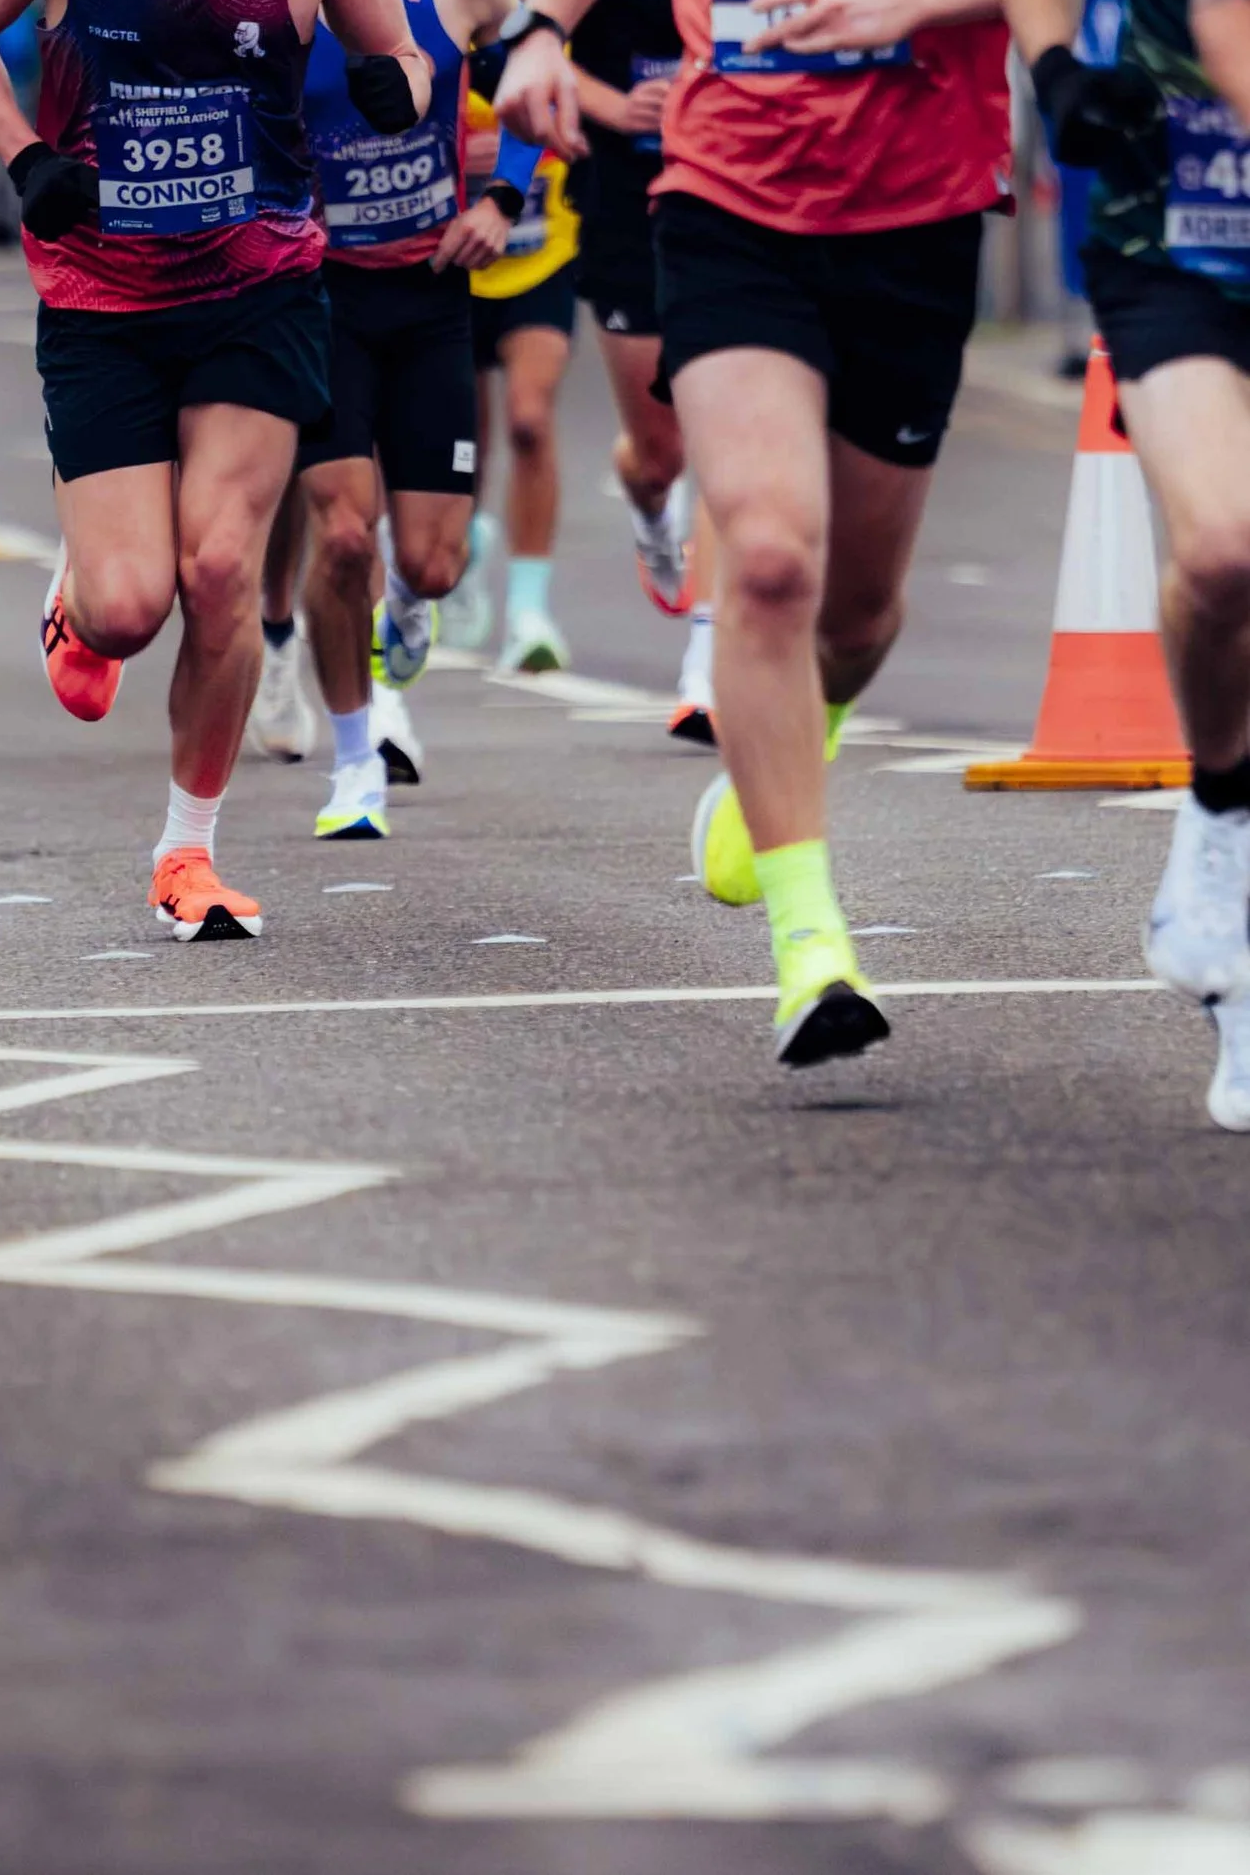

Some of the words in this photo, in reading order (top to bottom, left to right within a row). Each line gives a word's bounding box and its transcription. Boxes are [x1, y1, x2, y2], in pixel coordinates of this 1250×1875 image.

[88, 25, 141, 42] FRACTEL
[135, 105, 188, 118] SHEFFIELD
[135, 116, 162, 128] HALF
[164, 109, 229, 126] MARATHON
[122, 133, 226, 173] 3958
[116, 175, 237, 206] CONNOR
[345, 154, 435, 198] 2809
[352, 188, 433, 224] JOSEPH
